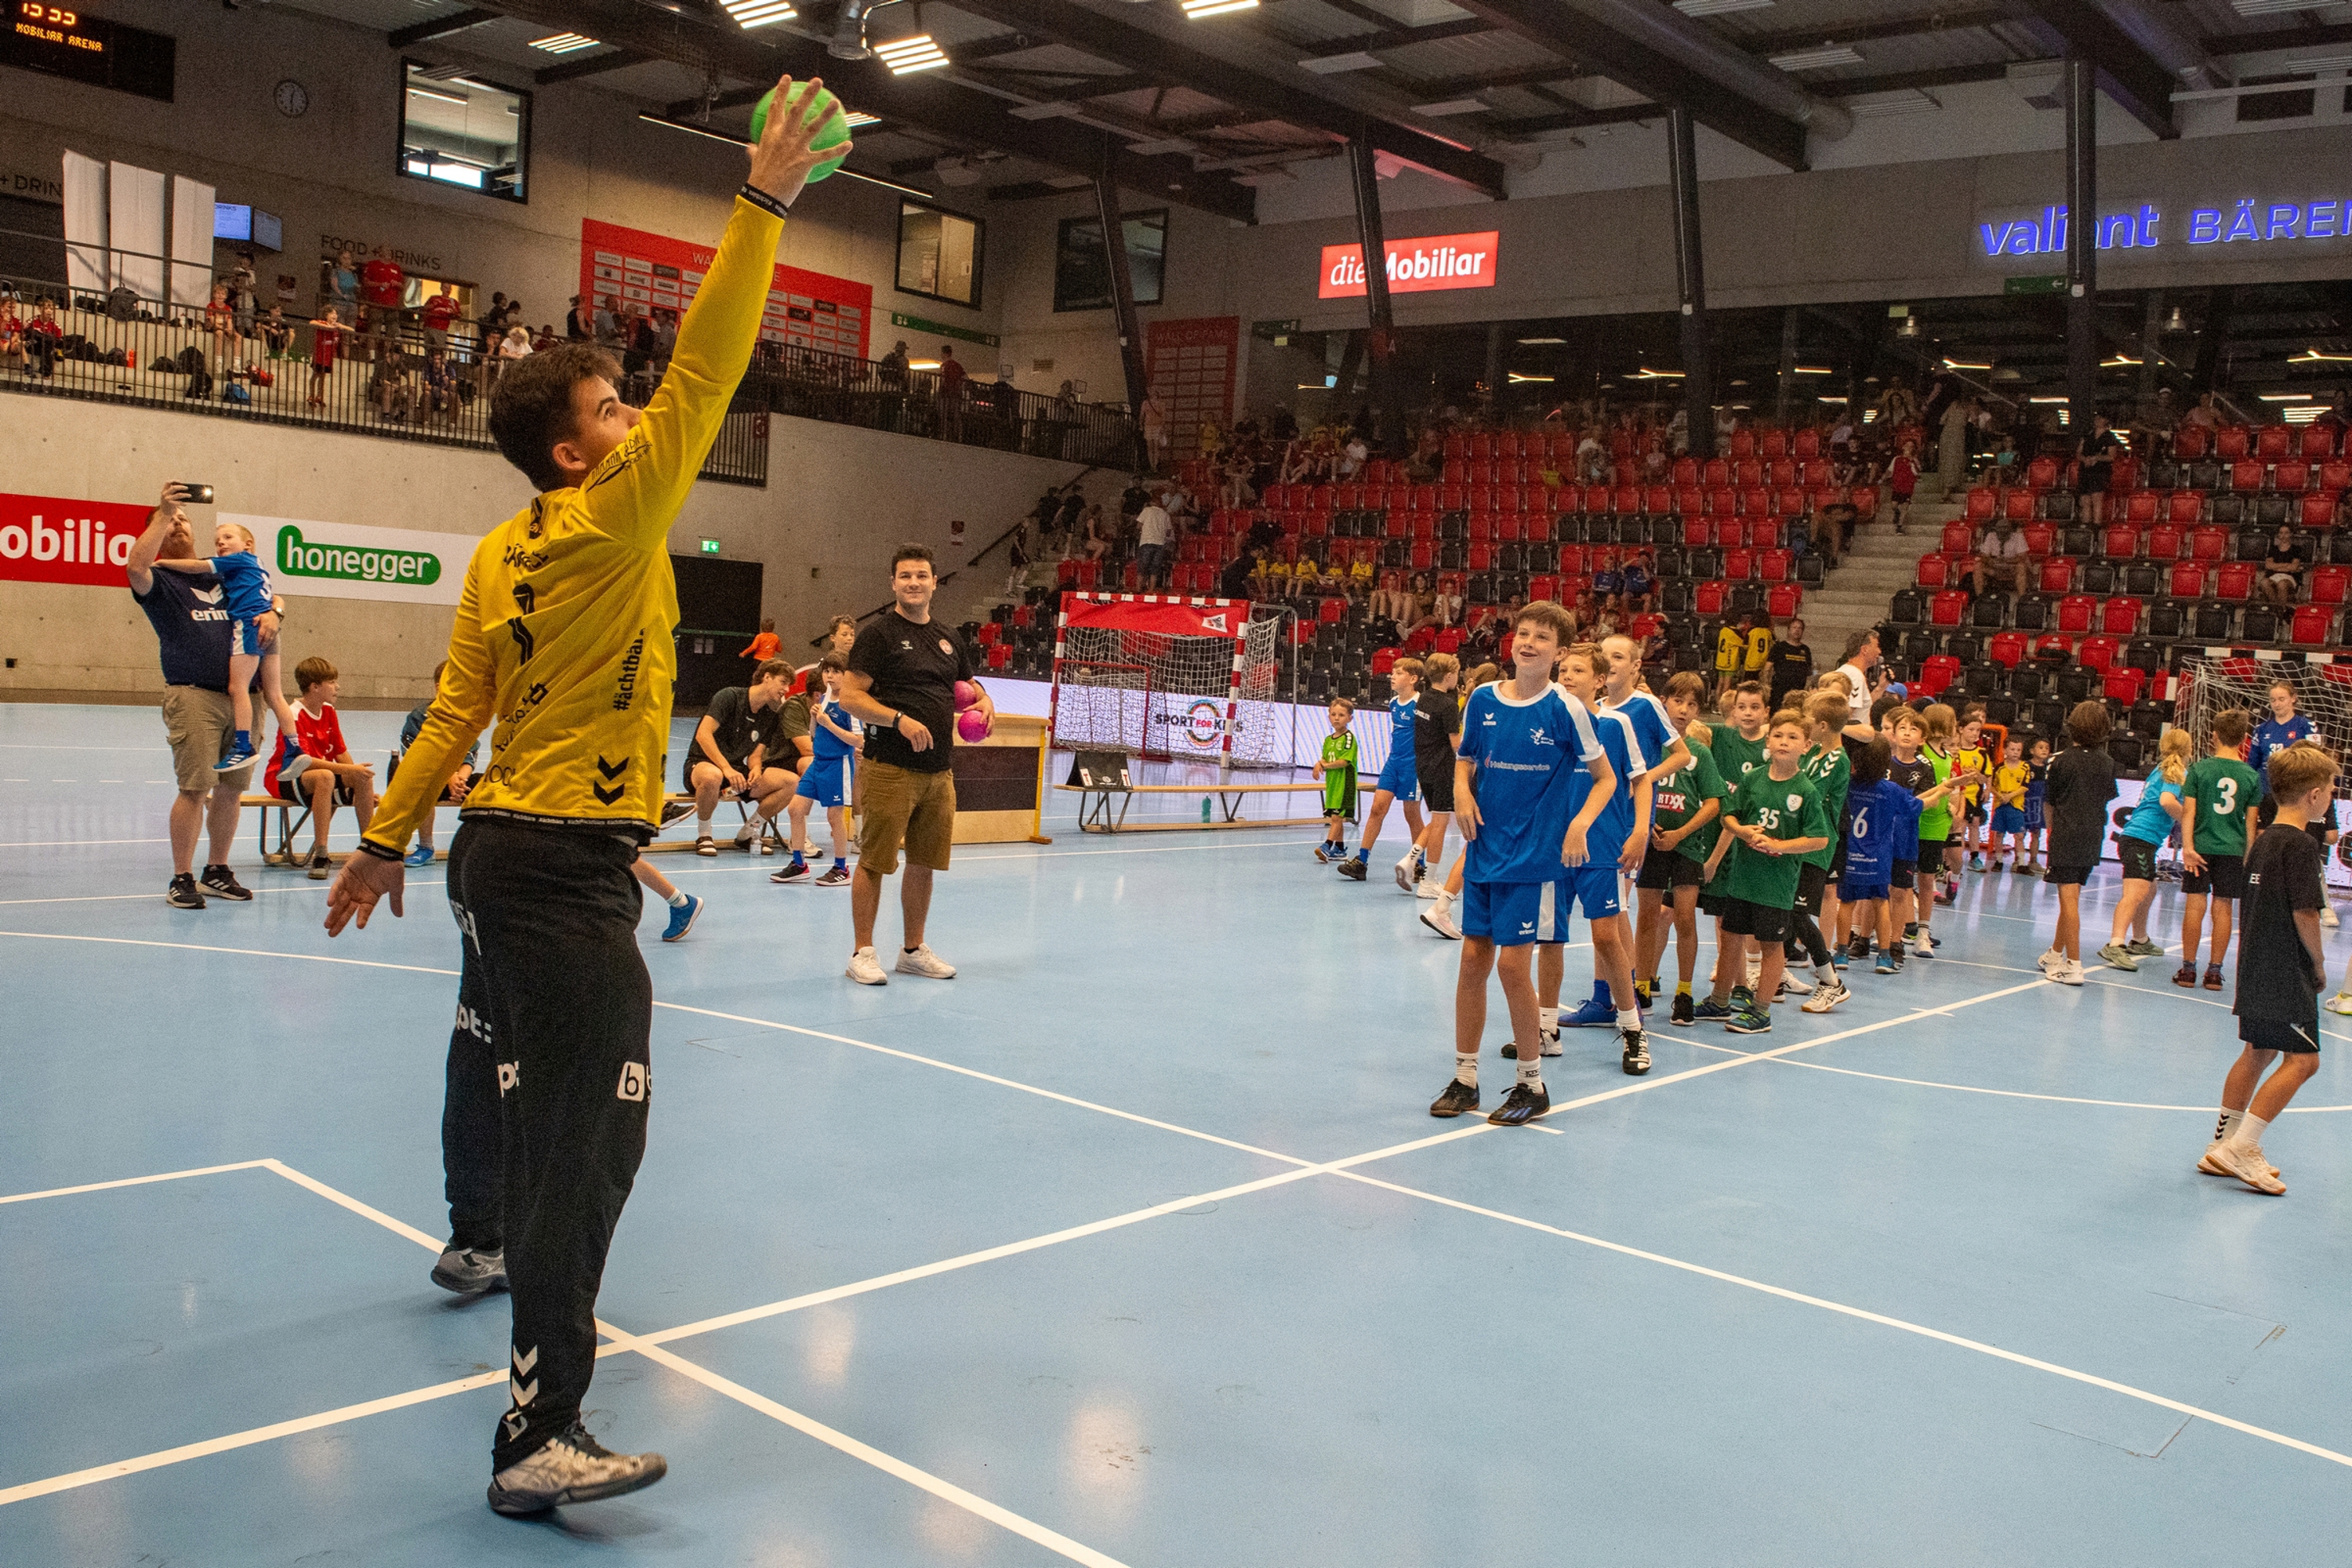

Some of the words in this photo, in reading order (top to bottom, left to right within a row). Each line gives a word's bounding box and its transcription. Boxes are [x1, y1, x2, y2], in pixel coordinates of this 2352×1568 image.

[16, 23, 64, 42] MOBILIAR
[68, 35, 103, 52] ARENA
[1980, 205, 2159, 256] valint
[321, 236, 368, 256] FOOD
[391, 249, 441, 270] RINKS
[1330, 256, 1365, 286] die
[1385, 247, 1486, 281] Mobiliar
[286, 535, 431, 581] honegger
[1156, 713, 1195, 728] SPORT
[1214, 719, 1243, 732] KIS
[2213, 777, 2238, 815] 3
[1757, 807, 1780, 829] 35
